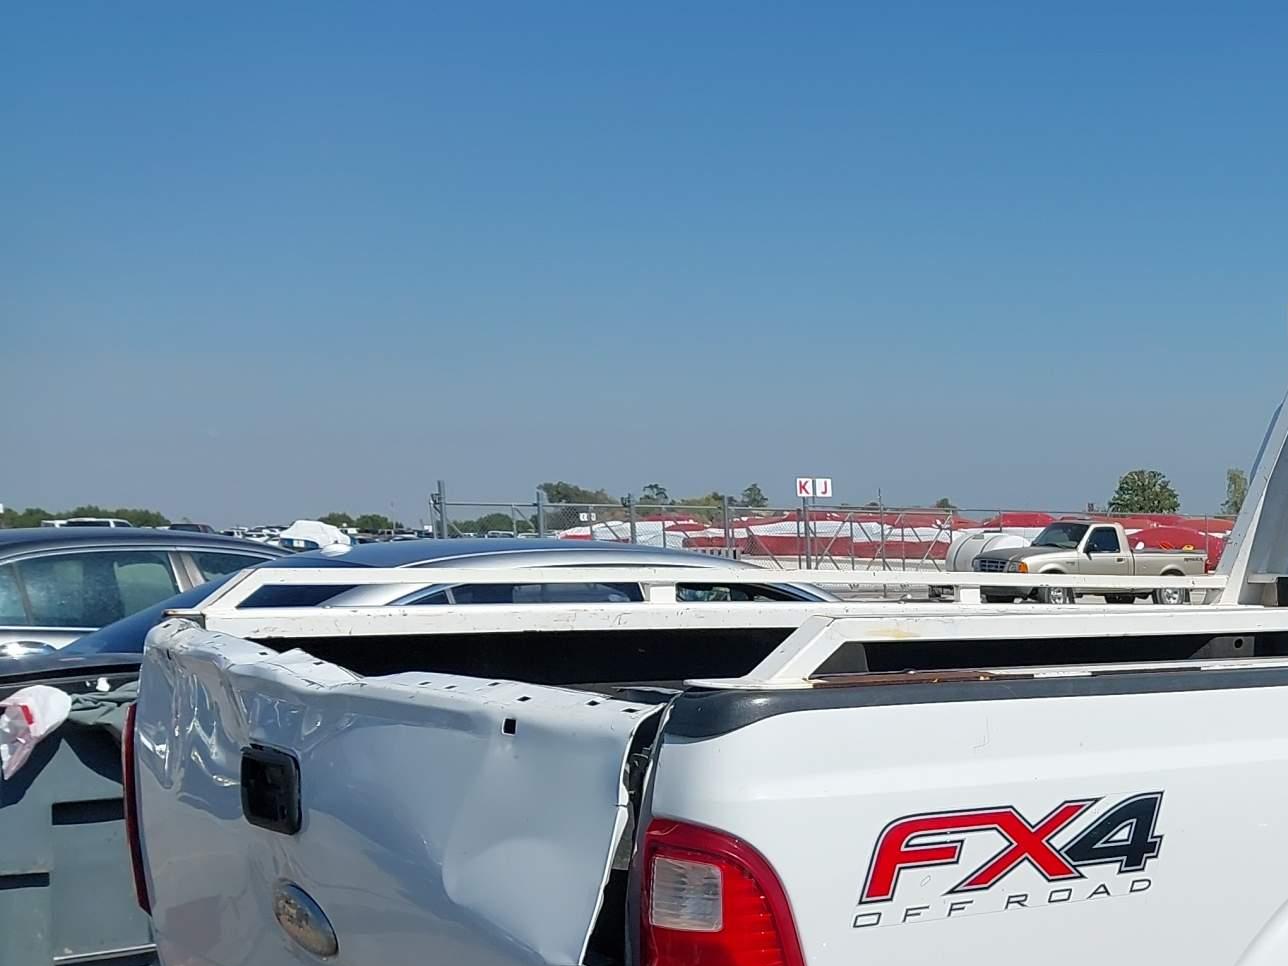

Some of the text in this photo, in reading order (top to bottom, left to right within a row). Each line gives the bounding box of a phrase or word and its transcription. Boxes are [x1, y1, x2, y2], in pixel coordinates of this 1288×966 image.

[799, 480, 810, 495] K
[858, 790, 1165, 906] FX4
[851, 878, 1153, 929] OFF ROAD
